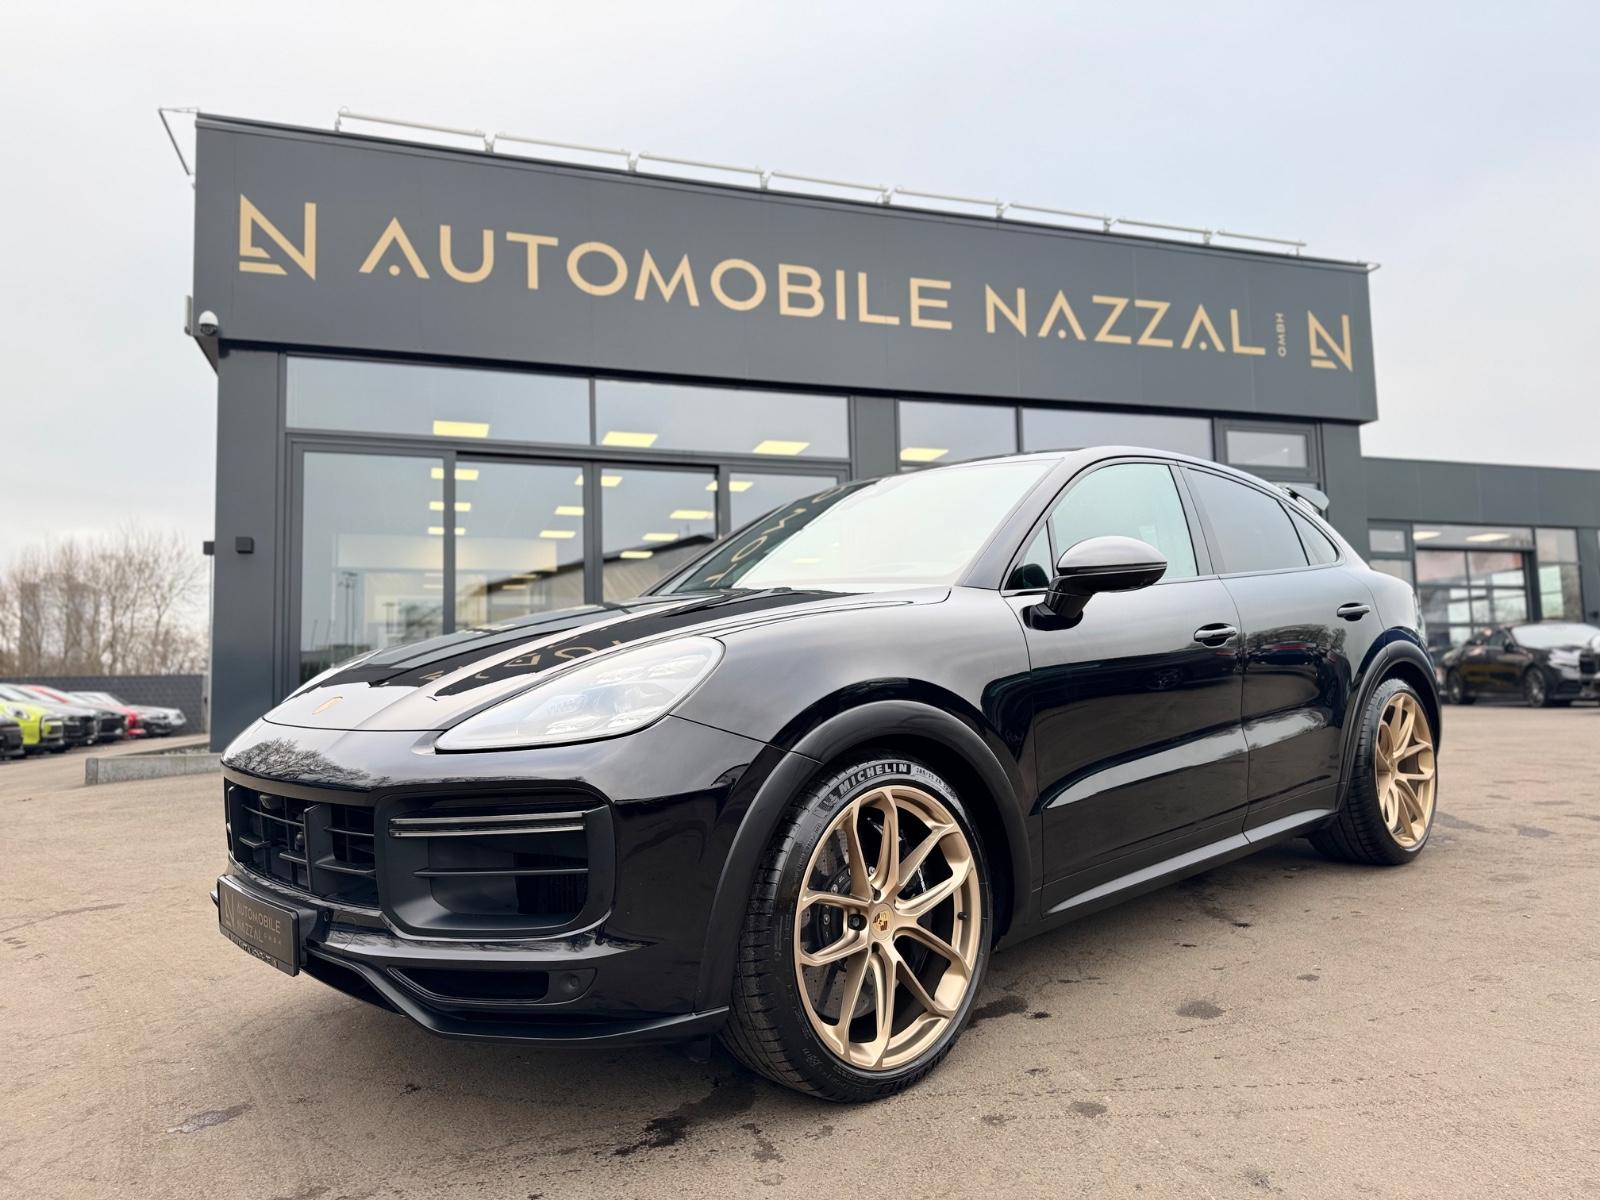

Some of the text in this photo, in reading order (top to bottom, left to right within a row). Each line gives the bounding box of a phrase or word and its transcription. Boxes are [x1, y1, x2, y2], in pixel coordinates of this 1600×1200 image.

[359, 217, 953, 332] AUTOMOBILE
[984, 283, 1267, 357] NAZZAL
[839, 763, 909, 795] MICHELIN
